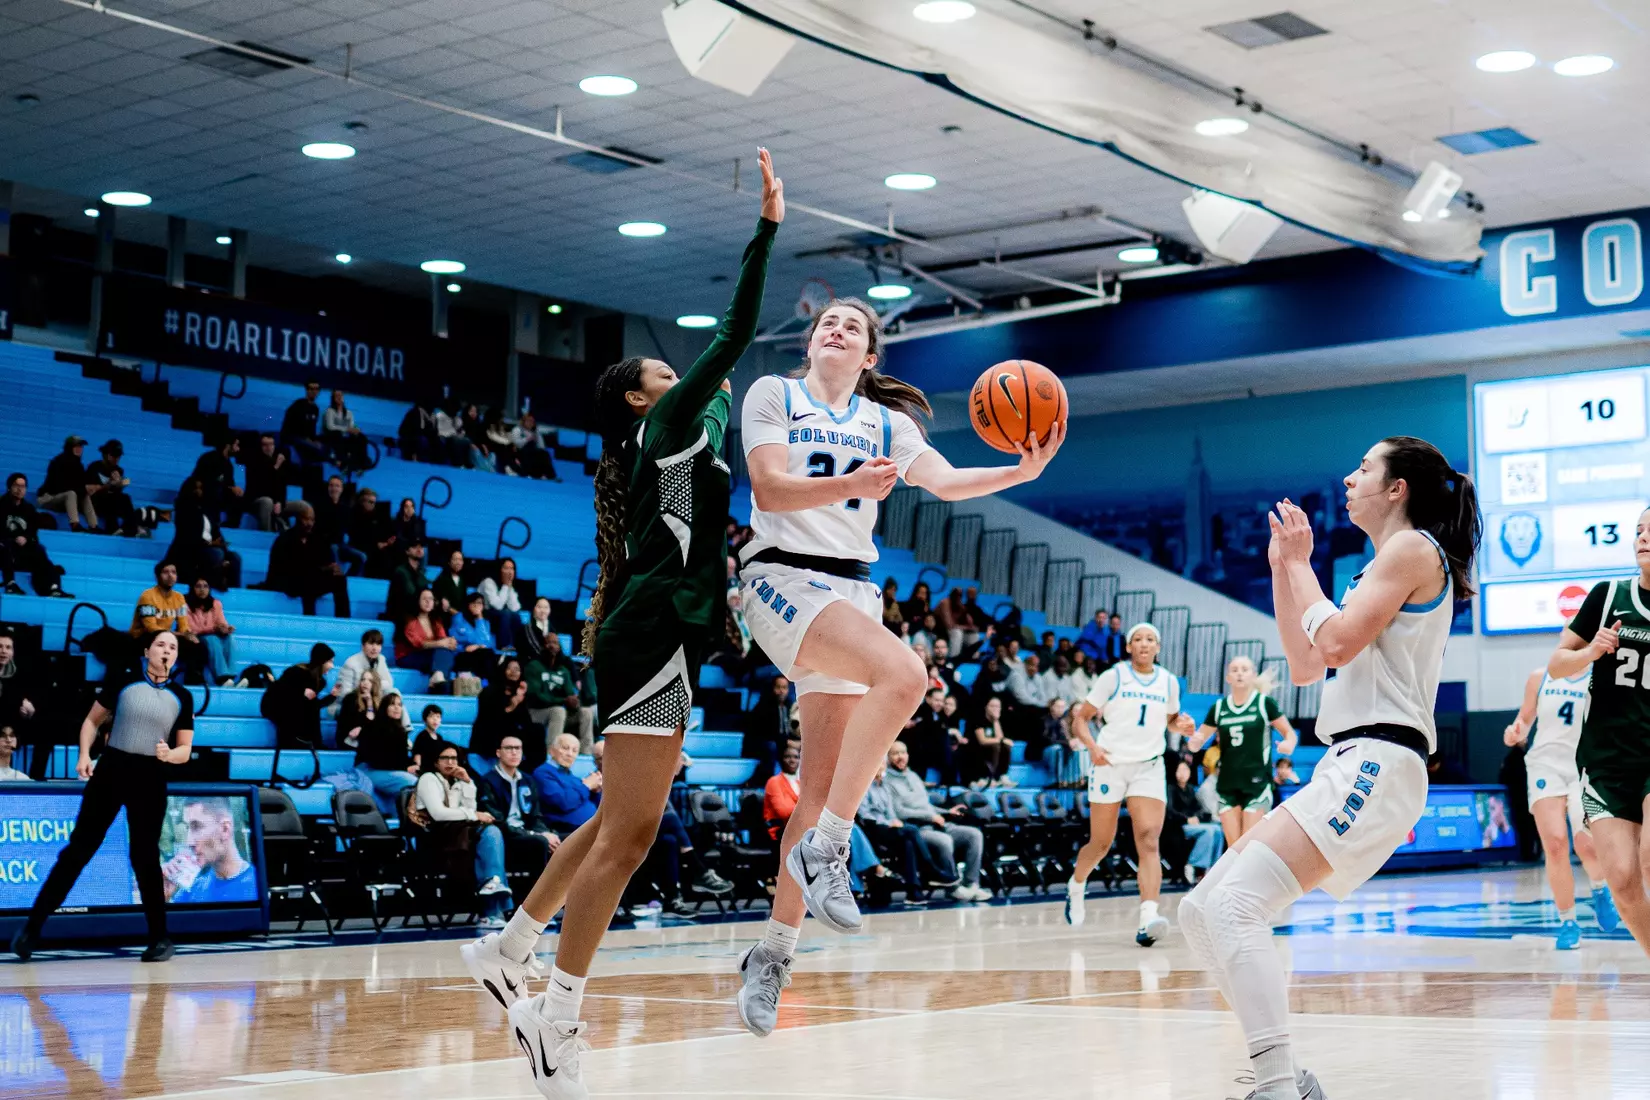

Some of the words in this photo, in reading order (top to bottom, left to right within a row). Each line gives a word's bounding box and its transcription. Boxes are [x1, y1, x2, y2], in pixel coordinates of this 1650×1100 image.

[165, 308, 405, 381] #ROARLIONROAR
[1580, 399, 1615, 421] 10
[788, 427, 878, 458] COLUMBIA
[1585, 523, 1620, 546] 13
[1138, 704, 1147, 727] 1
[1557, 701, 1575, 726] 4
[1229, 725, 1244, 747] 5
[1328, 760, 1380, 836] LIONS
